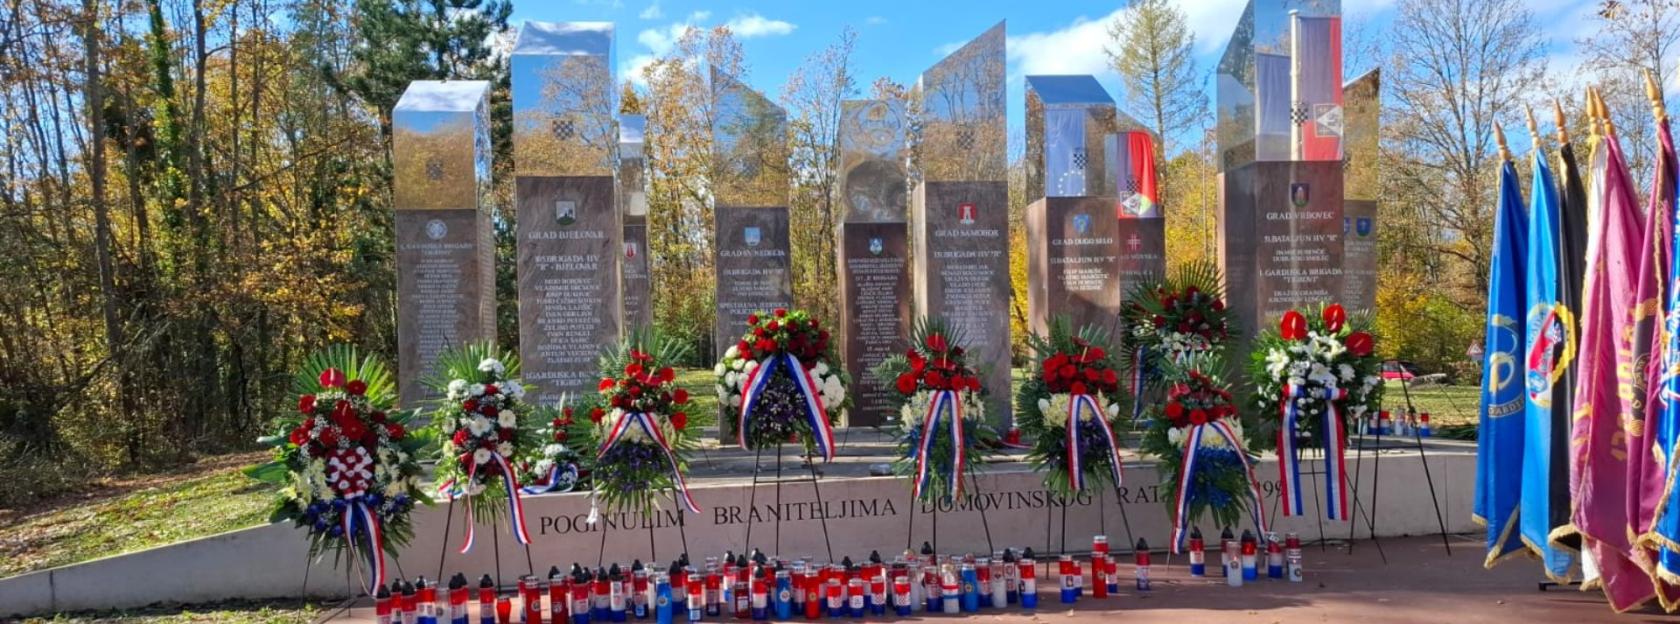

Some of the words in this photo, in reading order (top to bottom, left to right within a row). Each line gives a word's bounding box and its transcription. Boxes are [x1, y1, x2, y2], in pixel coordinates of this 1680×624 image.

[1266, 212, 1292, 220] GRAD
[1295, 211, 1335, 219] VRBOVEC
[528, 231, 557, 239] GRAD
[559, 230, 604, 239] BJELOVAR
[960, 229, 999, 237] SAMOBOR
[556, 263, 598, 271] BJELOVAR
[540, 509, 686, 535] POGINULIM
[713, 498, 897, 525] BRANITELJIMA
